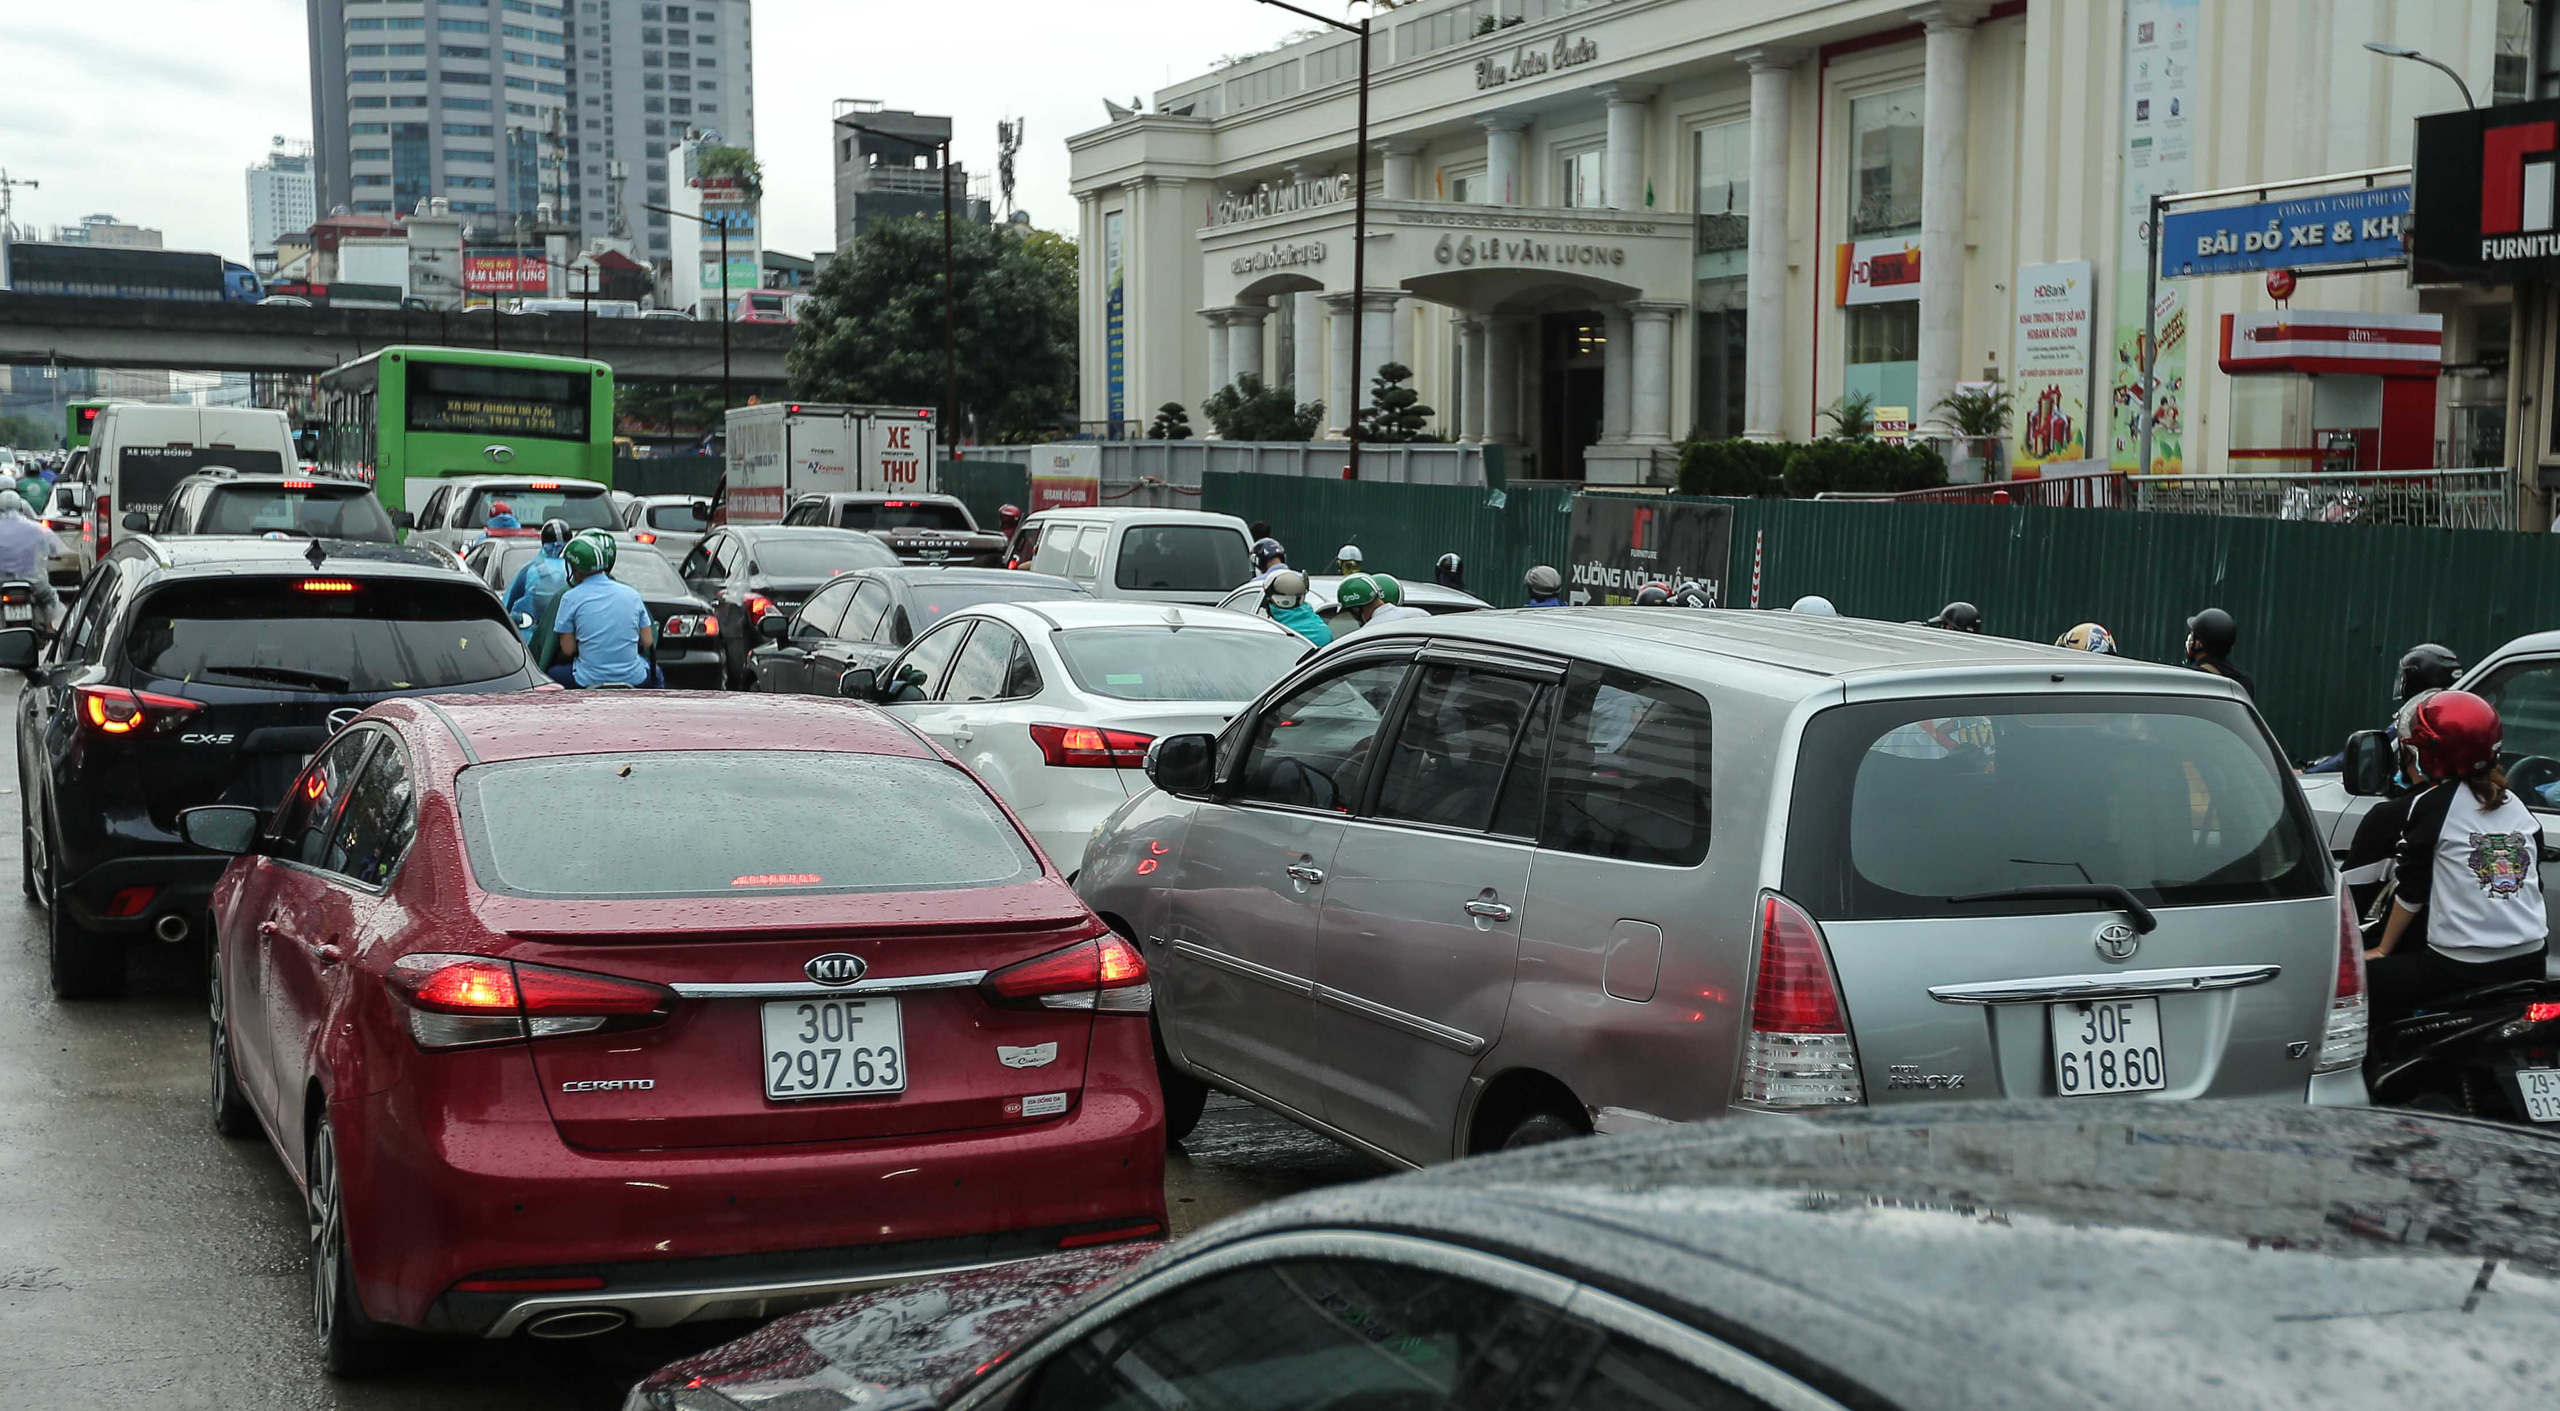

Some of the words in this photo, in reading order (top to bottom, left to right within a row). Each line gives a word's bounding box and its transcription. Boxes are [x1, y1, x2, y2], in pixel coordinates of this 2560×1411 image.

[2197, 228, 2240, 257] BÃI
[2245, 219, 2283, 252] ĐỖ
[2289, 223, 2327, 248] XE
[2331, 220, 2353, 243] &
[2362, 214, 2405, 241] KH
[2481, 233, 2560, 261] FURNITU
[1434, 233, 1476, 265] 66
[1479, 238, 1500, 261] LÊ
[1506, 239, 1549, 262] VĂN
[1555, 243, 1626, 265] LƯƠNG
[1852, 258, 1904, 284] HDBank
[2034, 284, 2067, 298] HDBank
[2348, 329, 2371, 342] atm
[887, 426, 911, 449] XE
[127, 447, 139, 457] XE
[881, 459, 919, 484] THƯ
[1630, 548, 1658, 560] FURNITURE
[1571, 560, 1621, 587] XƯỞNG
[1343, 592, 1360, 602] Grab
[180, 733, 235, 745] CX-5
[815, 959, 859, 979] KIA
[796, 1001, 866, 1044] 30F
[2079, 1003, 2133, 1045] 30F
[771, 1046, 899, 1093] 297.63
[2060, 1046, 2161, 1092] 618.60
[562, 1079, 655, 1093] CERATO
